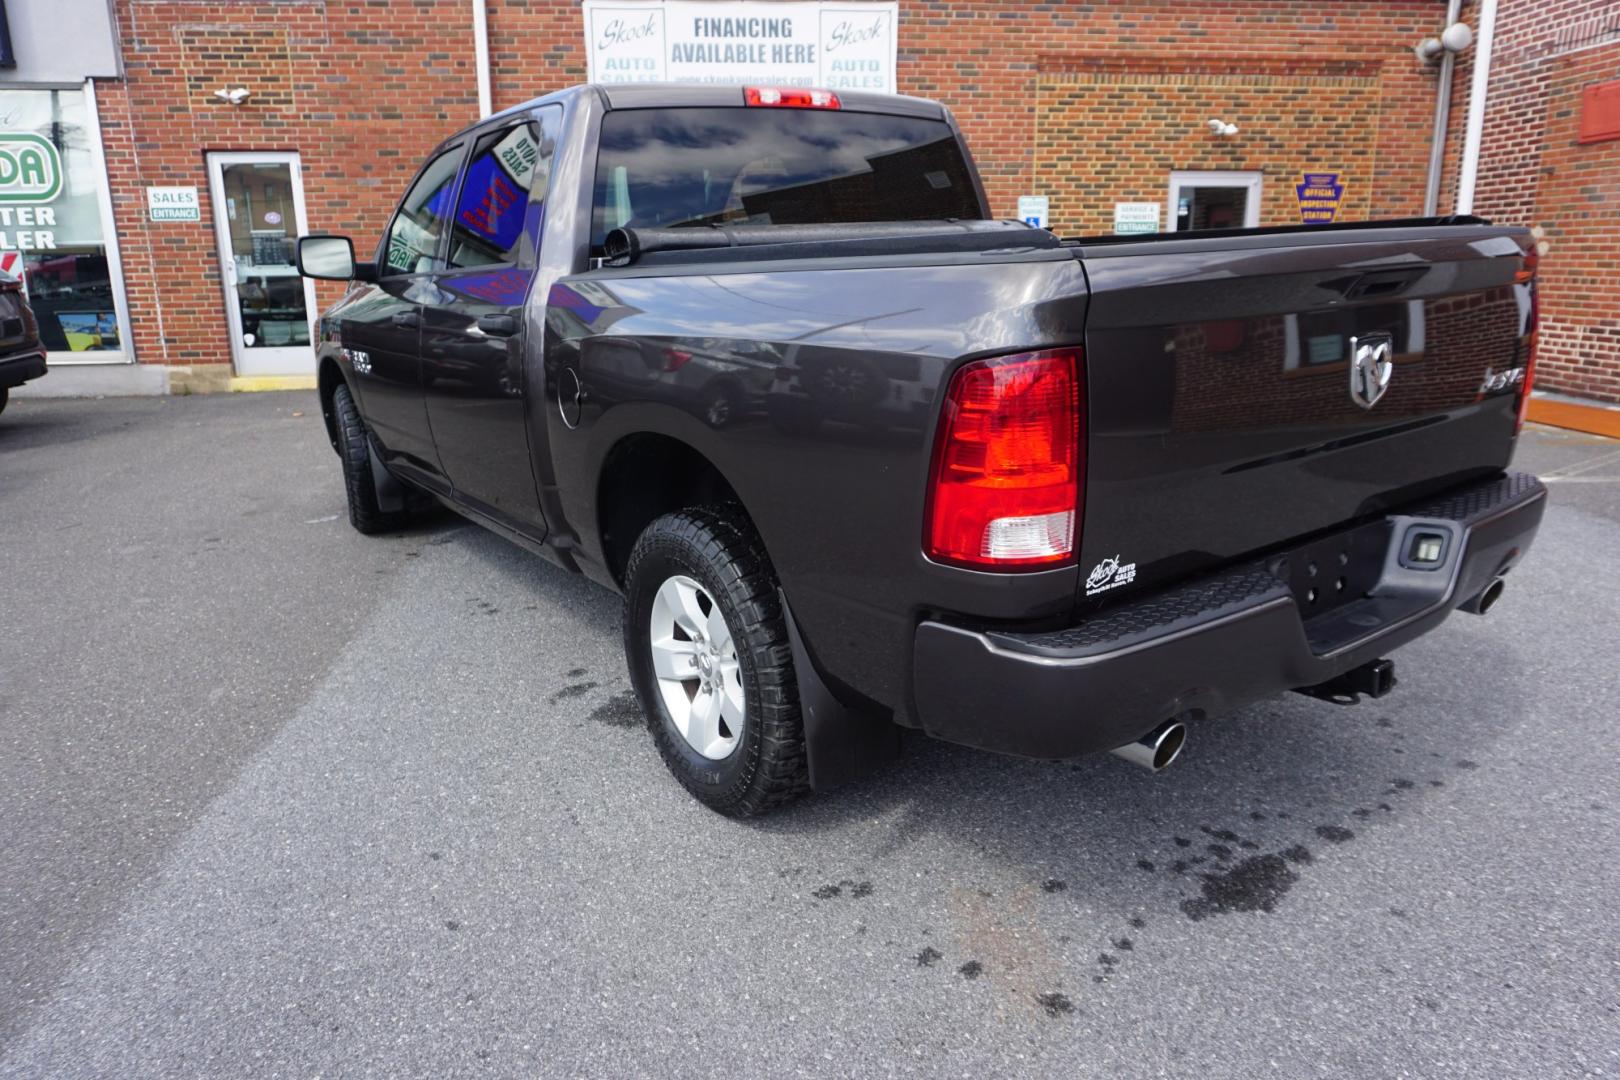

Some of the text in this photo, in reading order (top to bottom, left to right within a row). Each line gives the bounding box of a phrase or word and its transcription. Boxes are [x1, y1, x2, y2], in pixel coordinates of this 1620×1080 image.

[598, 12, 657, 50] Skook
[694, 17, 792, 38] FINANCING
[825, 15, 882, 52] Skook
[671, 43, 816, 63] AVAILABLE HERE
[605, 57, 656, 71] AUTO
[831, 59, 880, 72] AUTO
[826, 75, 884, 89] SALES
[152, 192, 194, 204] SALES
[1304, 188, 1336, 197] OFFICIAL
[0, 207, 56, 226] TER
[153, 208, 198, 219] ENTRANCE
[1118, 223, 1157, 232] ENTRANCE
[0, 231, 56, 250] LER
[1114, 569, 1137, 582] SALES
[1117, 563, 1136, 574] AUTO
